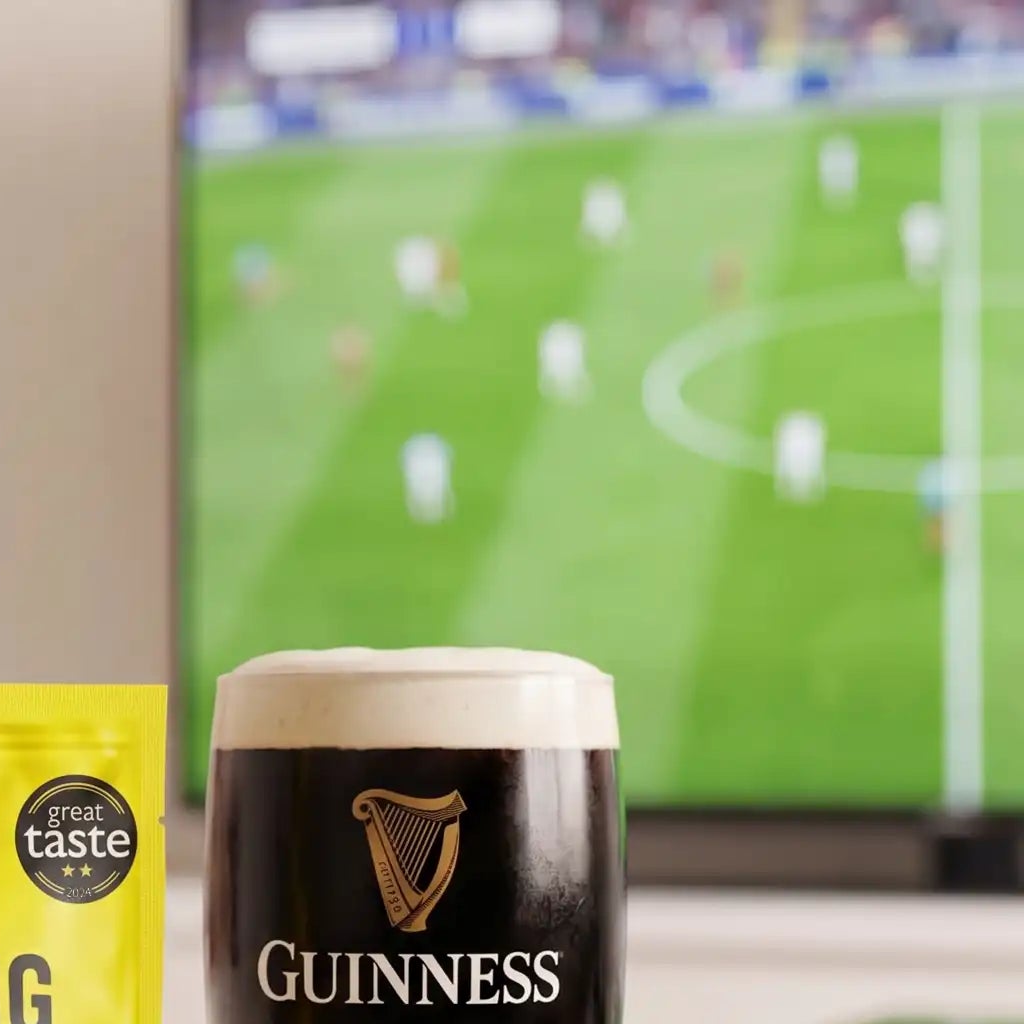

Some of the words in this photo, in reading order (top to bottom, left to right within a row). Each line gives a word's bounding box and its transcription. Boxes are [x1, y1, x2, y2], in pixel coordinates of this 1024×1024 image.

[48, 803, 104, 828] great
[23, 824, 131, 858] taste
[257, 939, 560, 1005] GUINNESS
